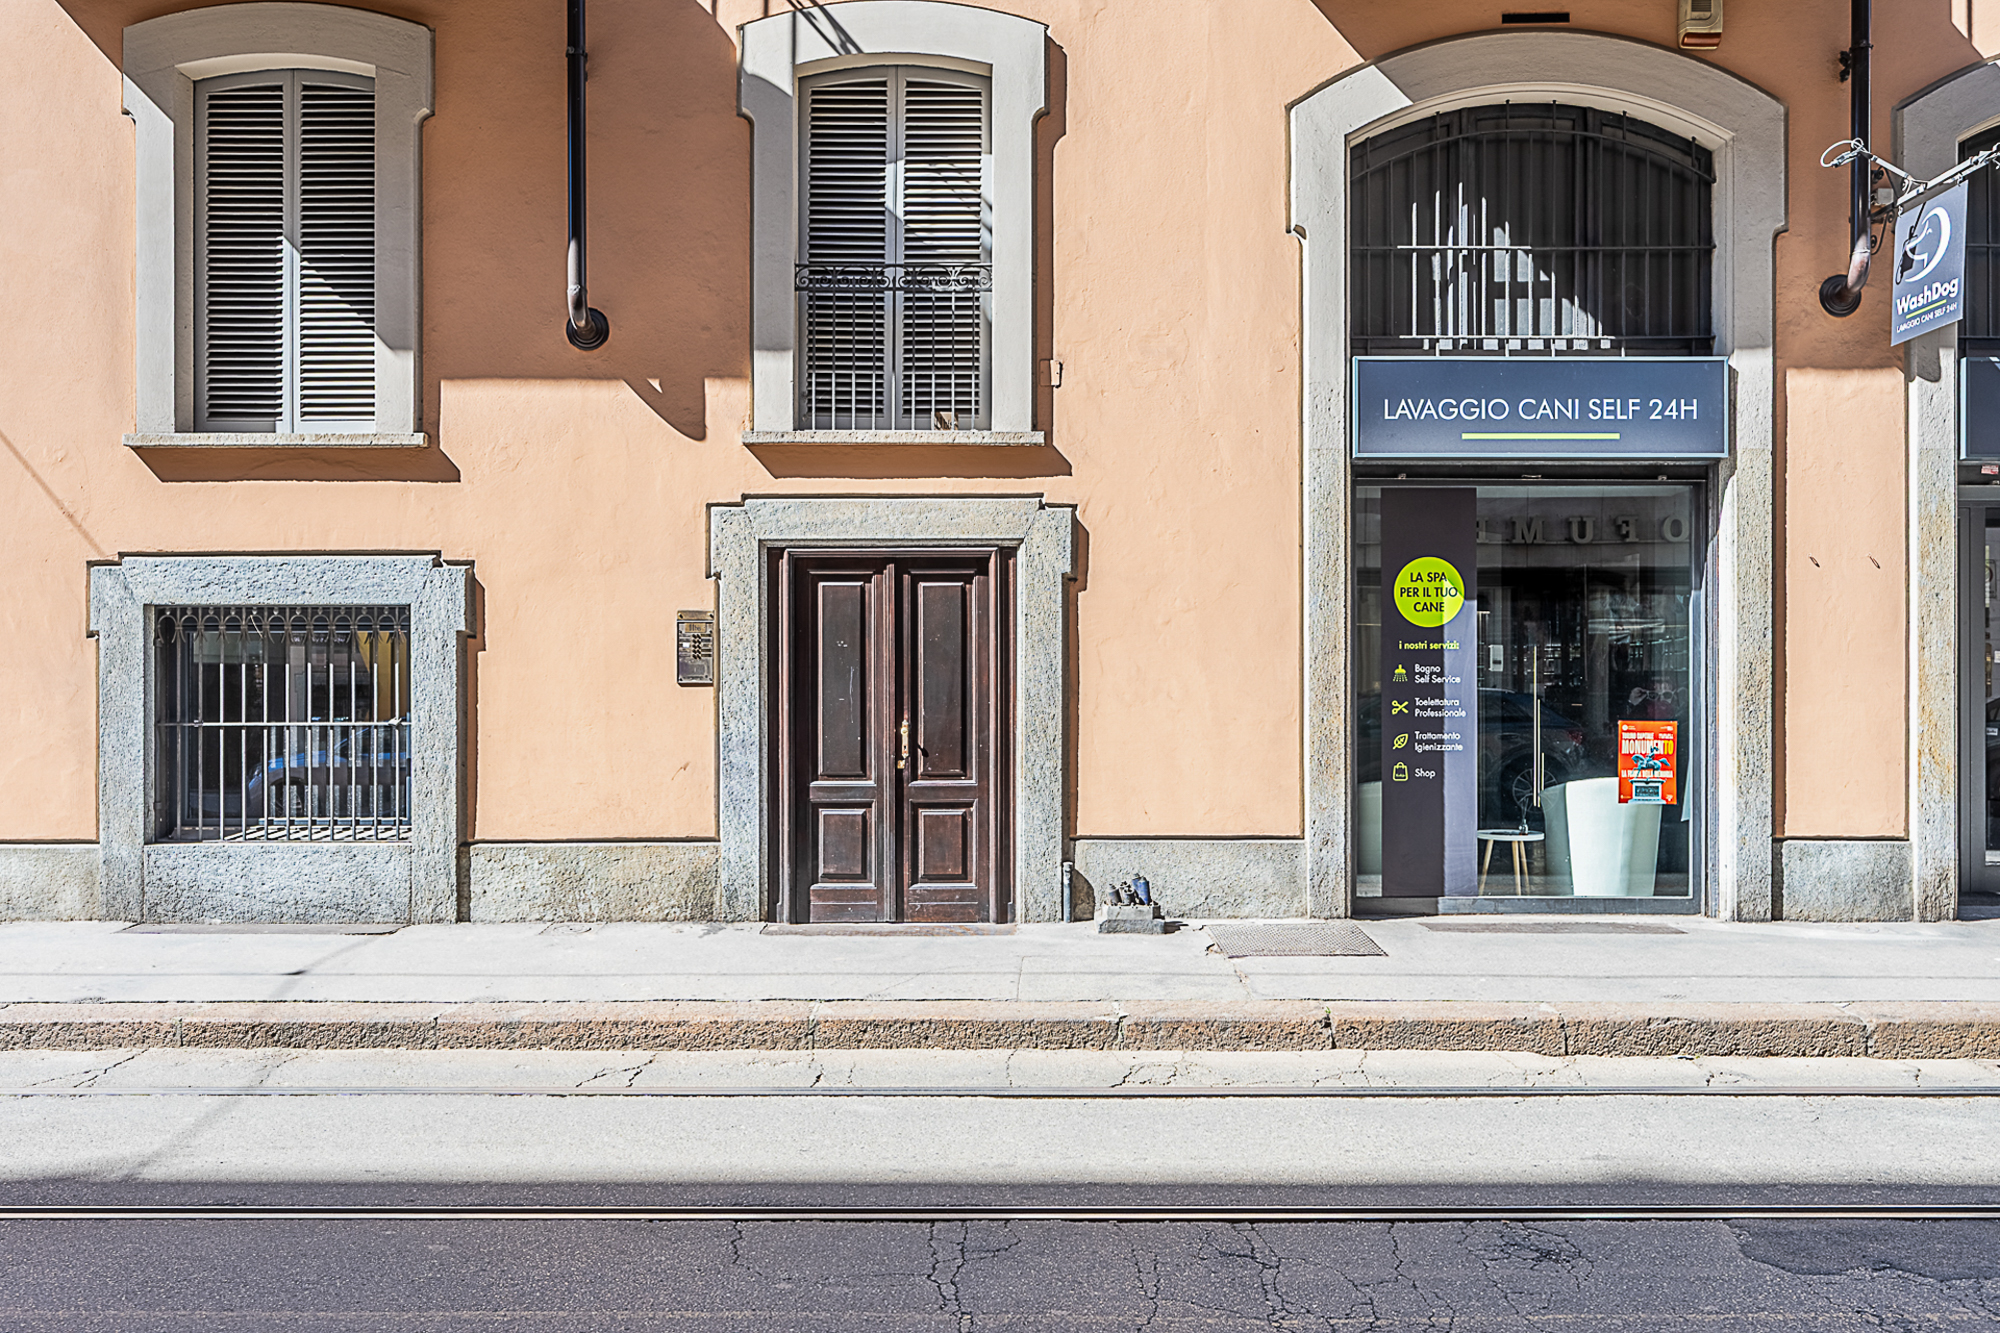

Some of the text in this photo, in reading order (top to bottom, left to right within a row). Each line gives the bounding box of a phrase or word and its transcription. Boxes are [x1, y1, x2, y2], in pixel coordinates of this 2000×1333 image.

[1896, 278, 1959, 315] WashDog
[1896, 318, 1920, 333] LAVAGGIO
[1921, 313, 1933, 323] CANI
[1934, 307, 1946, 318] SELF
[1384, 398, 1698, 420] LAVAGGIO CANI SELF 24H
[1410, 572, 1447, 583] LA SPA
[1400, 586, 1458, 598] PER IL TUO
[1413, 601, 1445, 612] CANE
[1404, 640, 1428, 650] nostri
[1429, 640, 1460, 650] servizi:
[1414, 664, 1441, 674] Bagno
[1414, 674, 1461, 683] Self Service
[1414, 697, 1460, 706] Toelettatura
[1414, 708, 1467, 718] Professionale
[1414, 731, 1461, 740] Trattamento
[1414, 742, 1464, 753] Igienizzante
[1622, 740, 1674, 754] MONUMENTO
[1414, 768, 1436, 779] Shop
